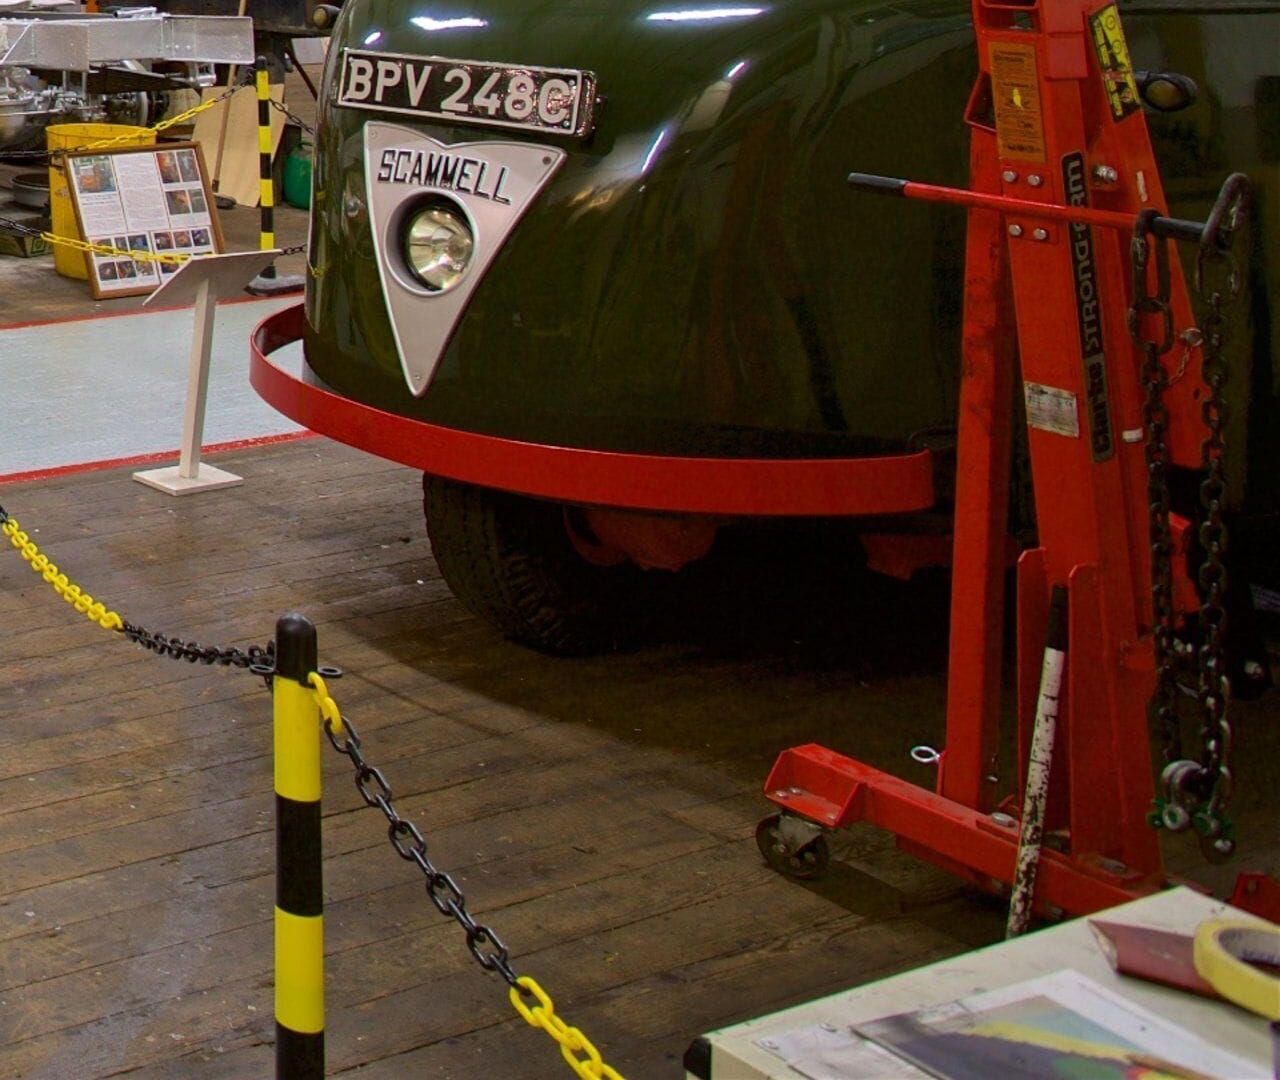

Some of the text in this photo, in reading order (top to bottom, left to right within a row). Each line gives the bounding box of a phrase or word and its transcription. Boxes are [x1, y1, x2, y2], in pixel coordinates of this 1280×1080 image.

[347, 59, 572, 123] BPV 248C
[377, 149, 513, 205] SCAMMELL
